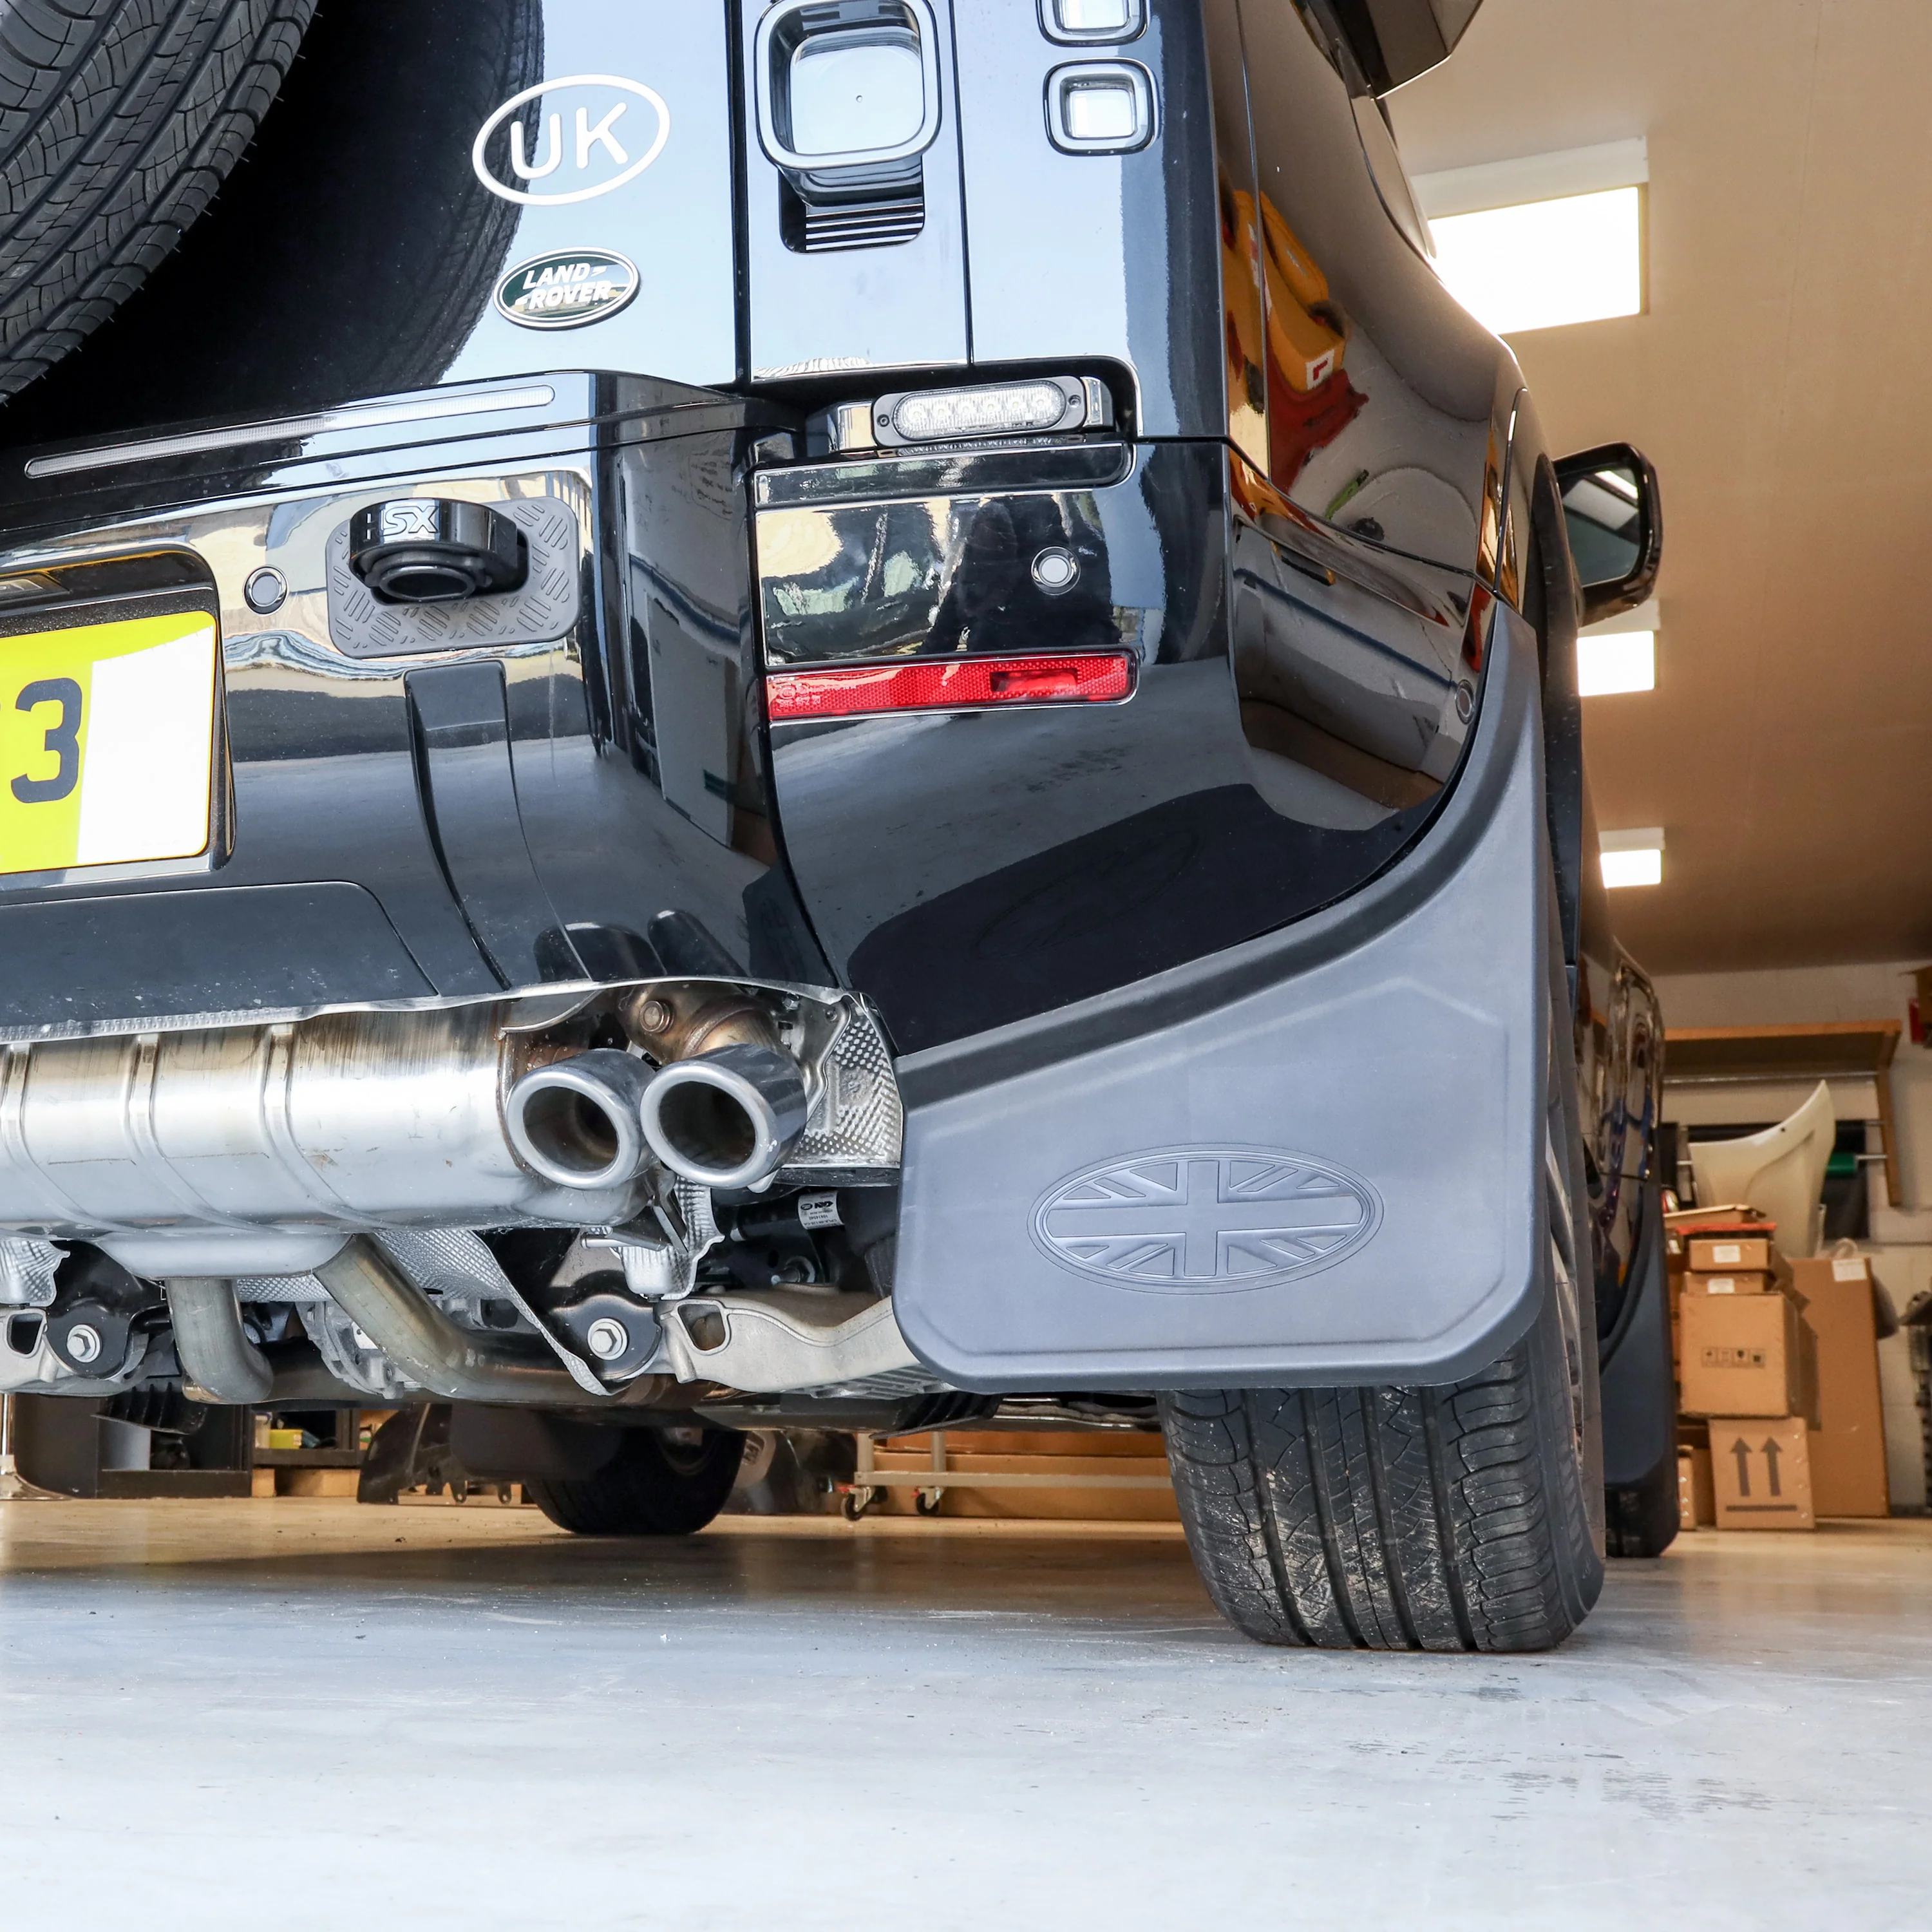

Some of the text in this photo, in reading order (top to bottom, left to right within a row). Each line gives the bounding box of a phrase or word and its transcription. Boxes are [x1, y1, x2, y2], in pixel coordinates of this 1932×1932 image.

[510, 102, 629, 180] UK
[522, 262, 592, 290] LAND
[528, 281, 612, 310] ROVER
[10, 677, 82, 804] 3
